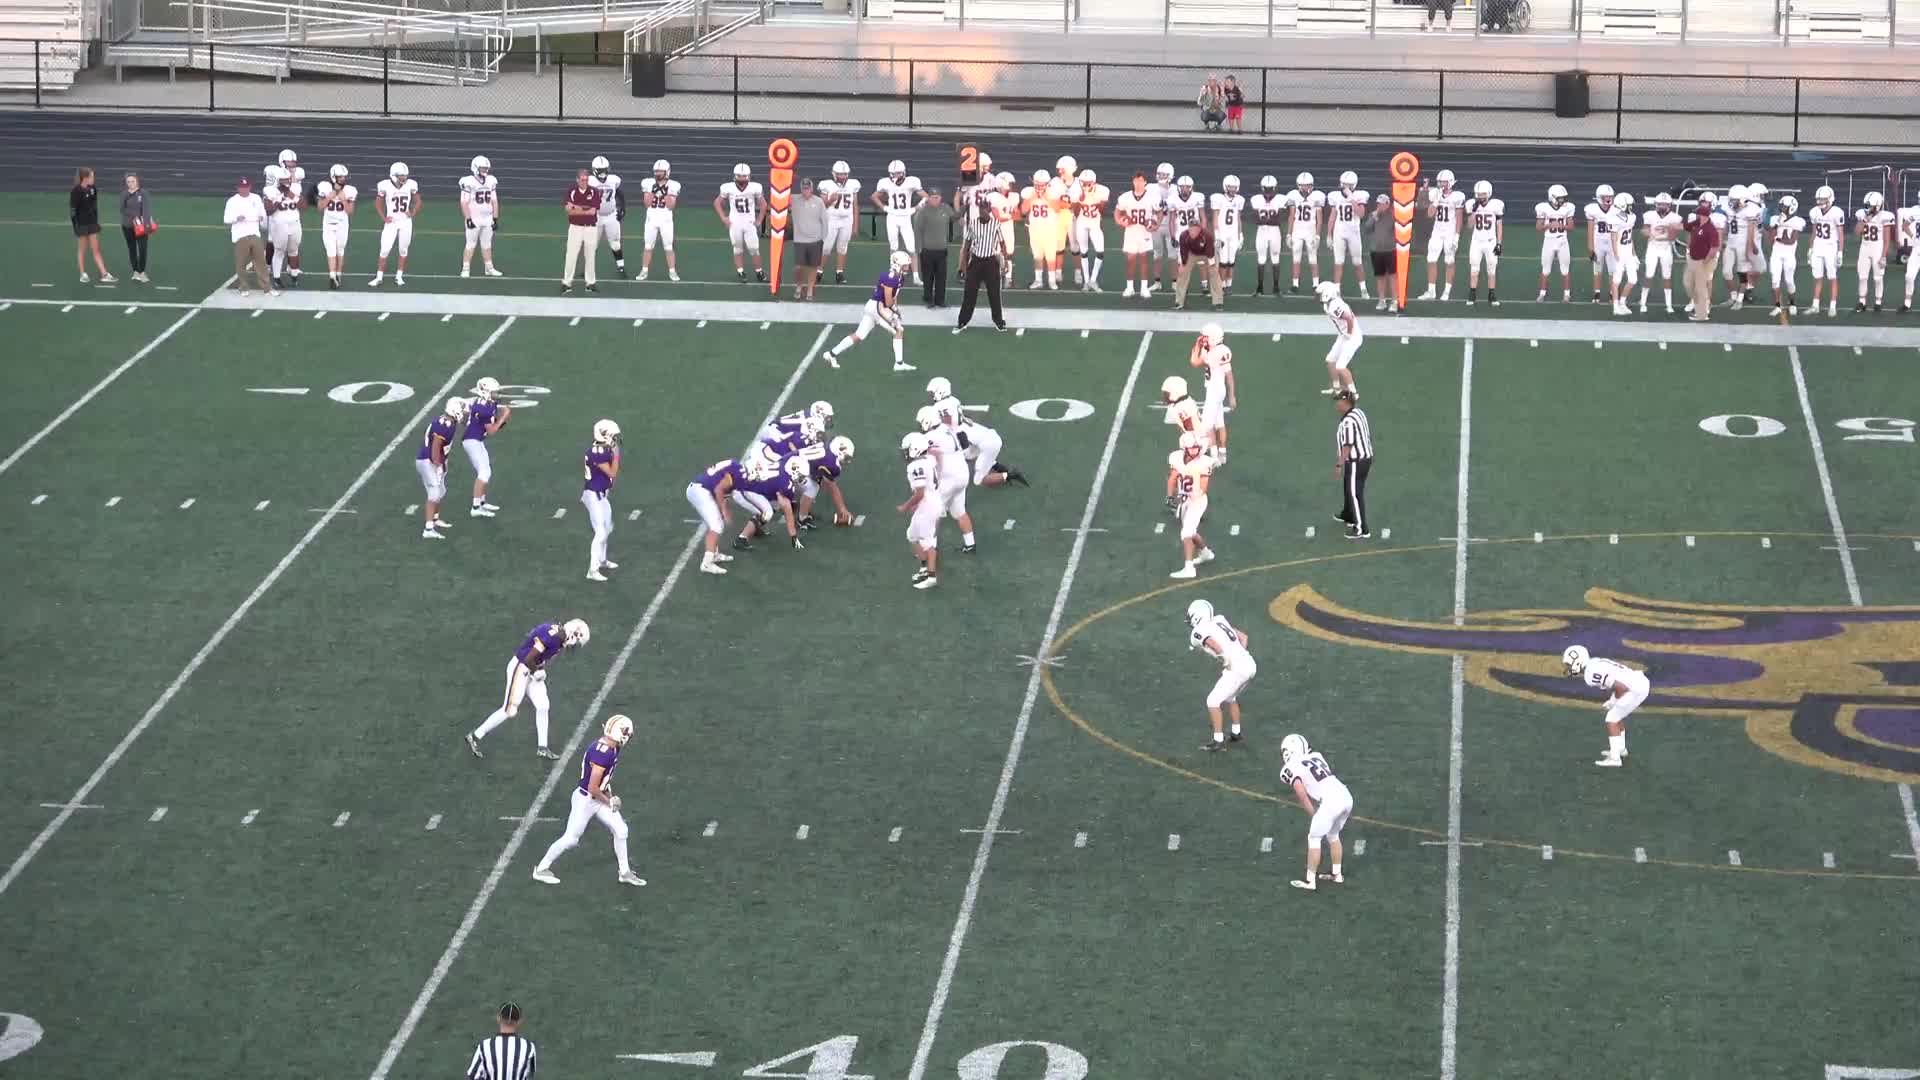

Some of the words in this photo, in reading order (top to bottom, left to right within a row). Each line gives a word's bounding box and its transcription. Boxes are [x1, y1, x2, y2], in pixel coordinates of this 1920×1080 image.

[960, 146, 977, 172] 2
[391, 196, 408, 213] 35
[834, 194, 851, 210] 75
[892, 194, 907, 210] 13
[1032, 204, 1049, 218] 66
[1082, 203, 1099, 219] 82
[1130, 208, 1147, 225] 68
[1225, 208, 1235, 226] 6
[1298, 205, 1311, 222] 16
[1339, 205, 1353, 222] 18
[1437, 205, 1450, 223] 81
[1475, 213, 1492, 231] 85
[1816, 222, 1831, 240] 83
